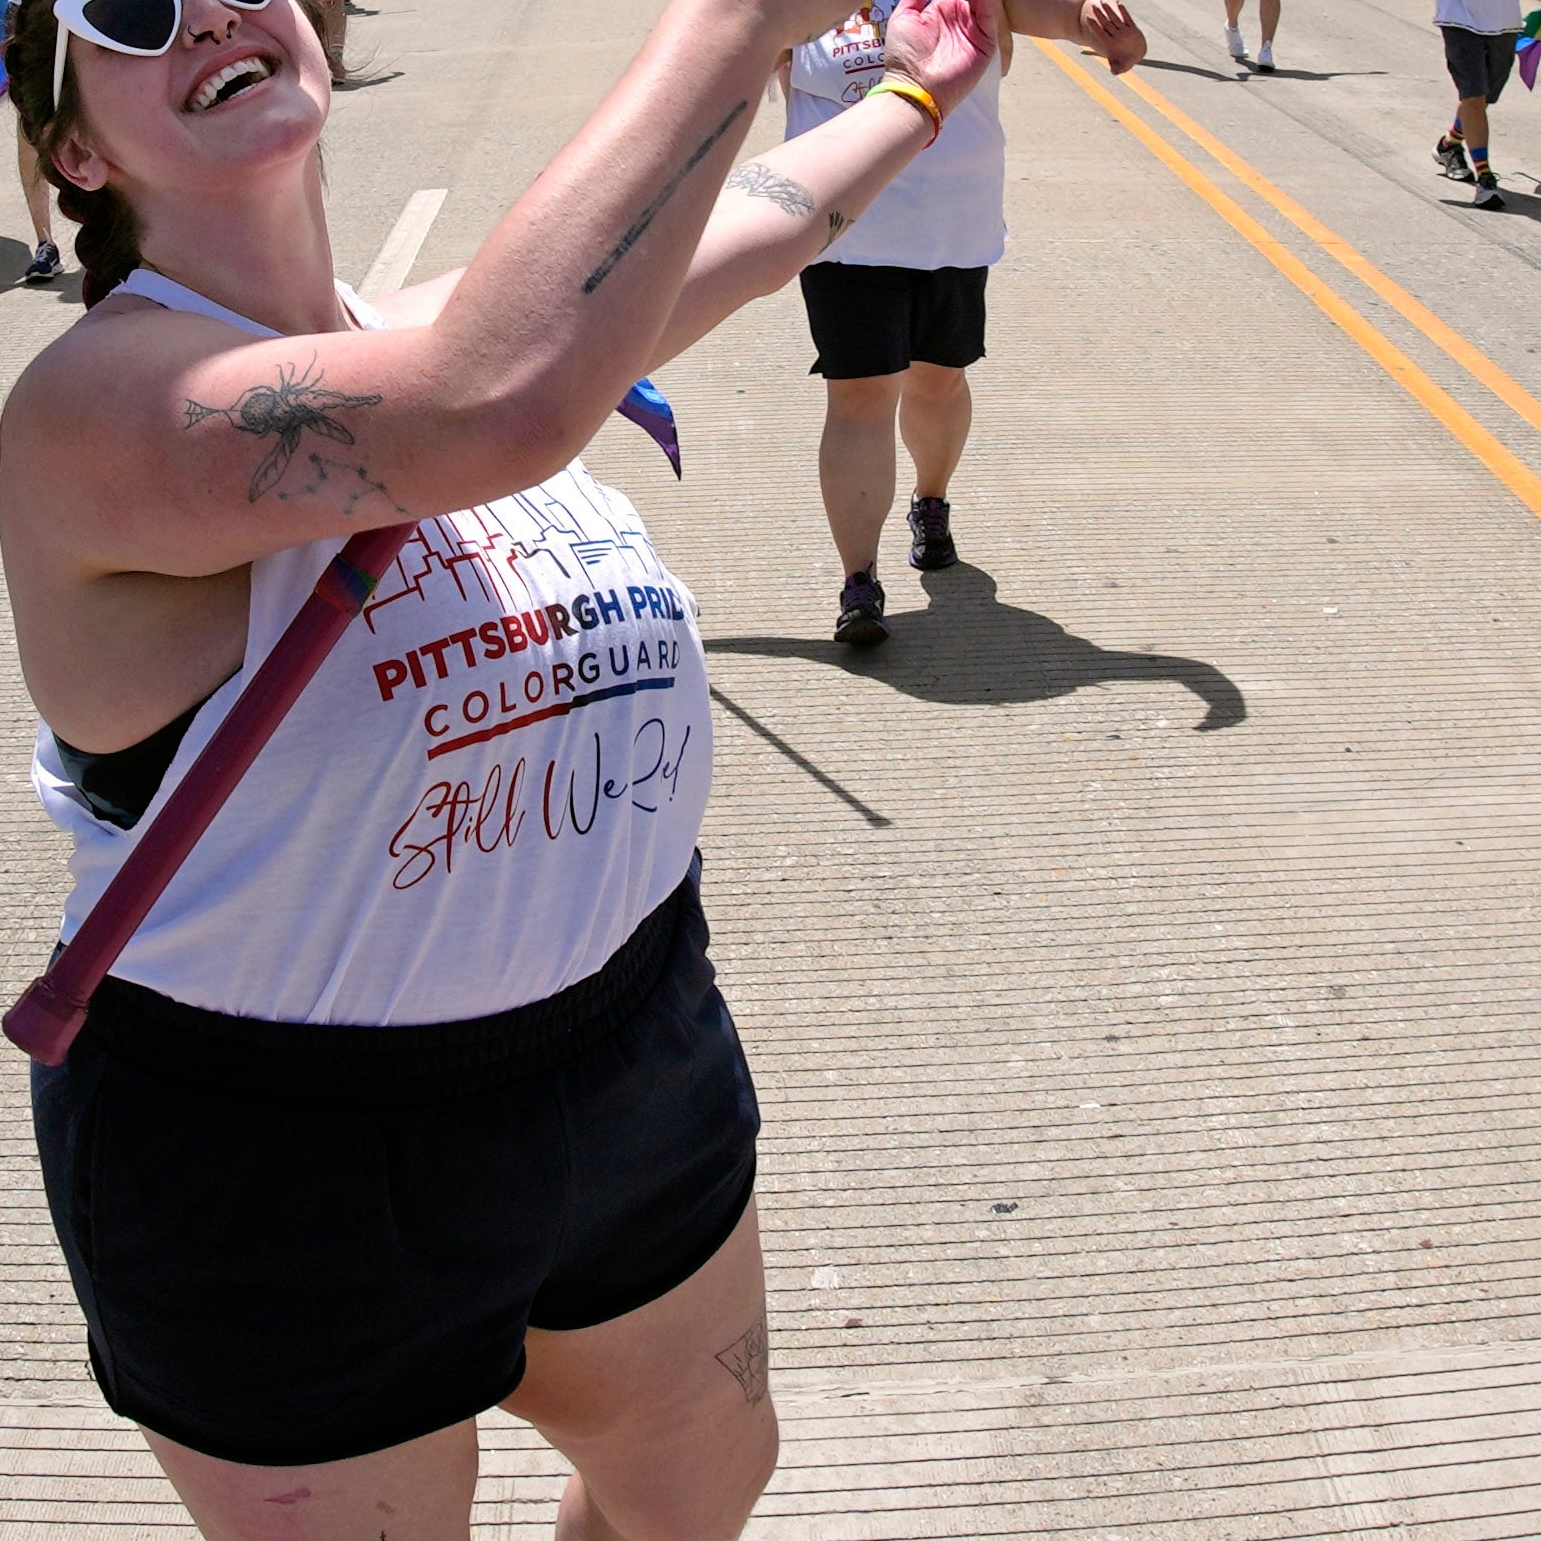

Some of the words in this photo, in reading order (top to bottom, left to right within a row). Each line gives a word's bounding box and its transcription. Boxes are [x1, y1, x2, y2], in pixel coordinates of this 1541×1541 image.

[832, 37, 885, 58] PITTSB
[372, 588, 626, 702] PITTSBURGH
[626, 585, 686, 621] PRID
[424, 640, 681, 737] COLORGUARD
[388, 757, 526, 890] Still
[543, 731, 629, 840] We
